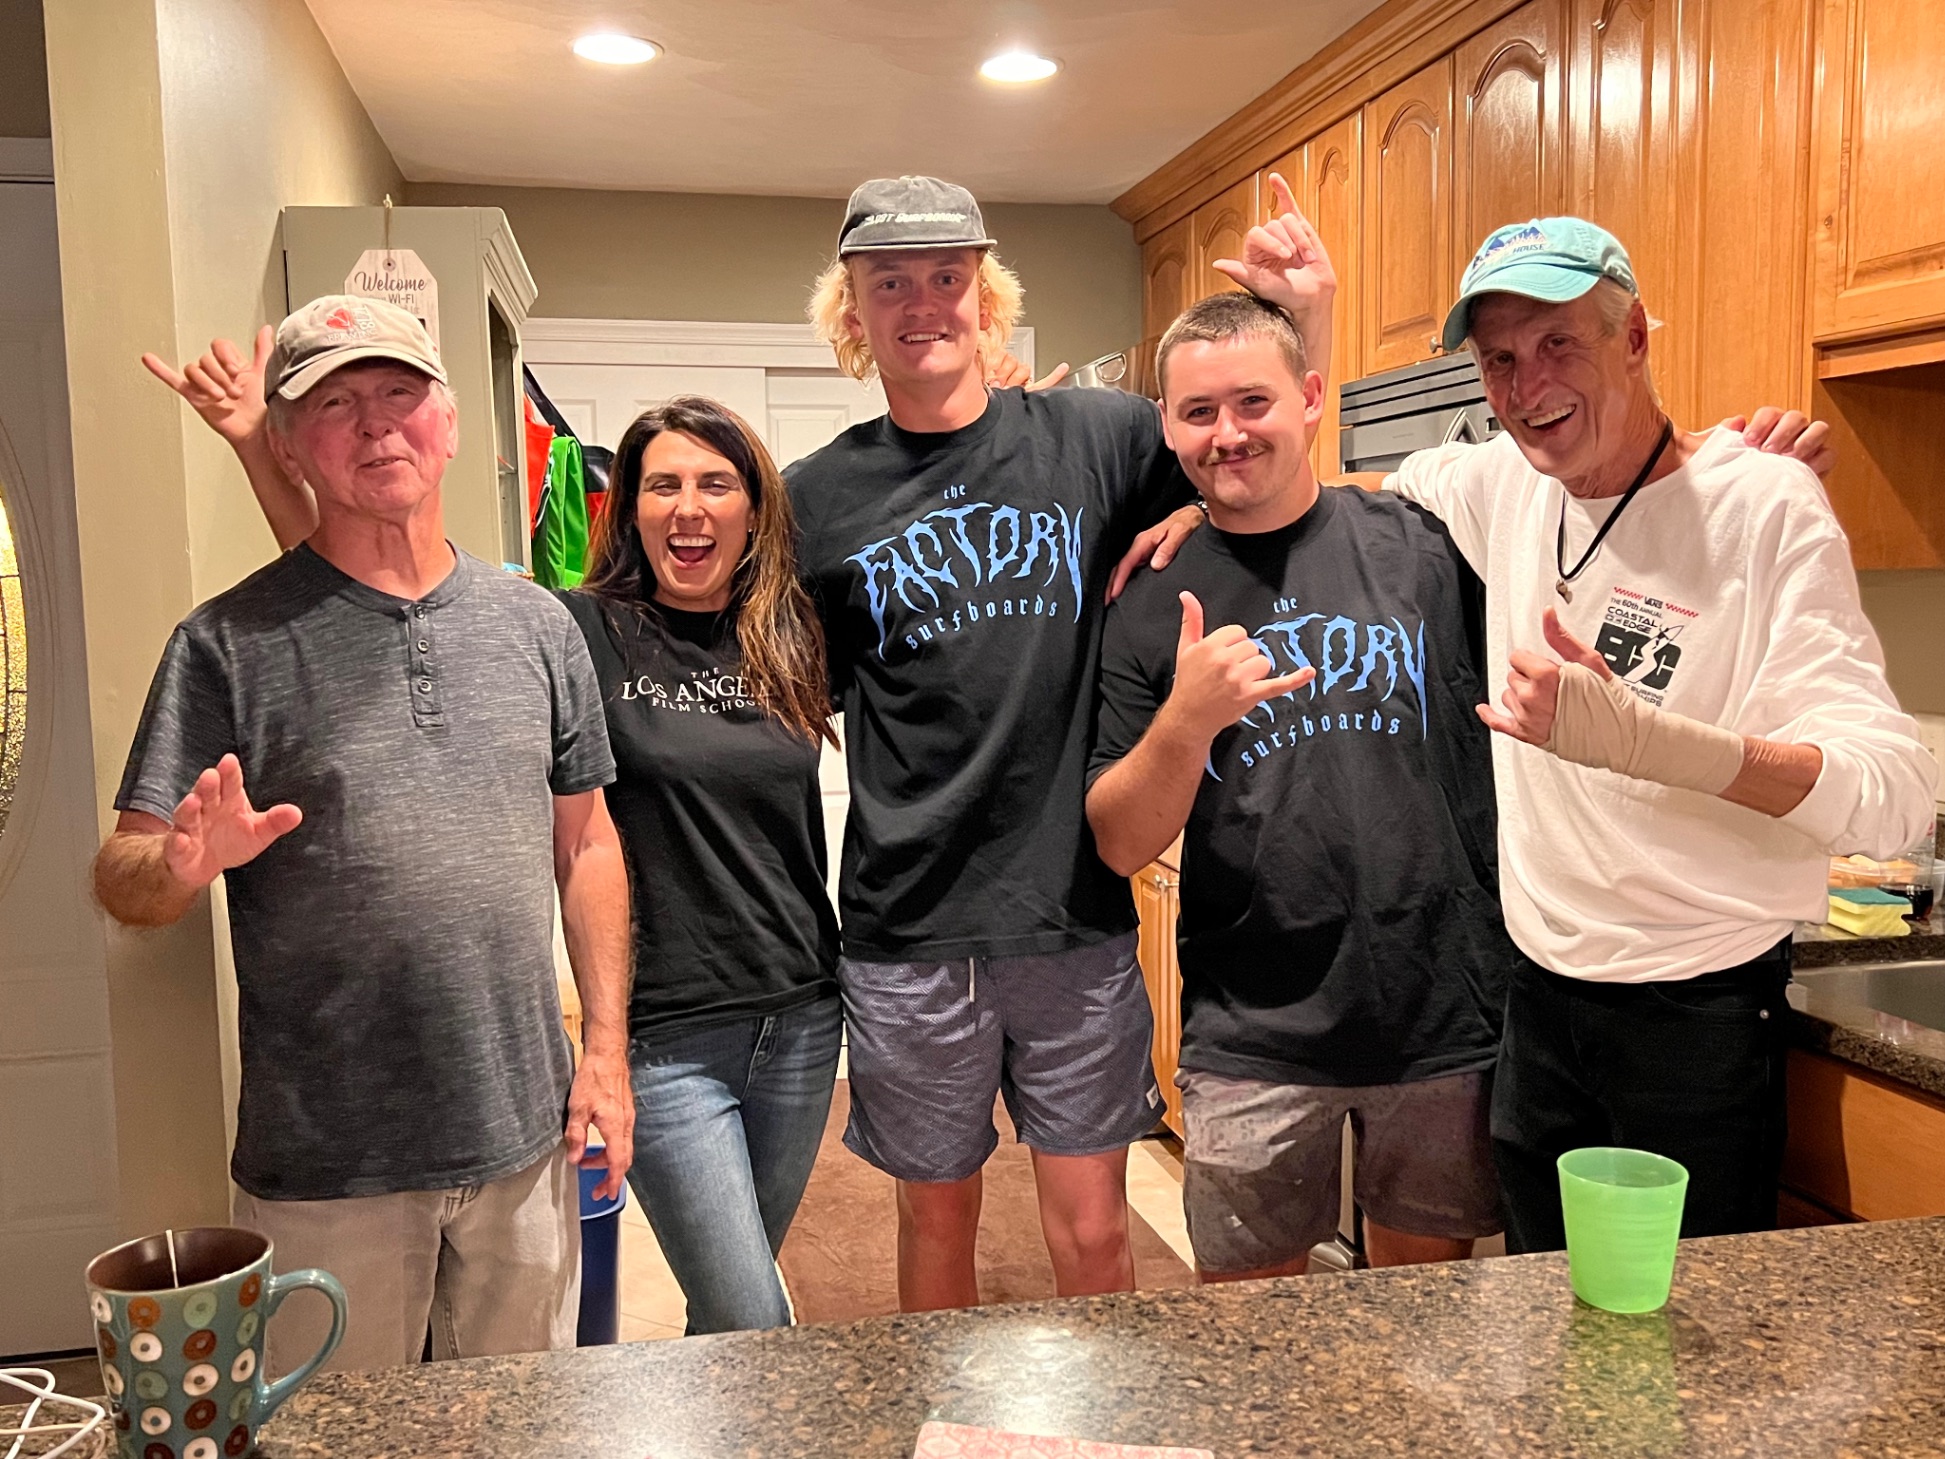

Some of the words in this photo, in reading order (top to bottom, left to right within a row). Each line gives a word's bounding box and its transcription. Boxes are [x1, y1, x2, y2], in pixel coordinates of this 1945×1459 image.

[354, 271, 427, 292] Welcome
[388, 293, 414, 304] WI-FI
[943, 483, 966, 500] the
[843, 501, 1083, 662] FACTORY
[1273, 596, 1298, 613] the
[905, 594, 1058, 650] surfboards
[1607, 606, 1658, 628] COASTAL
[1622, 619, 1652, 634] EDGE
[691, 667, 719, 678] THE
[621, 675, 668, 700] LOS
[652, 696, 691, 712] FILM
[700, 699, 762, 714] SCHOO
[1241, 709, 1401, 768] surfboards
